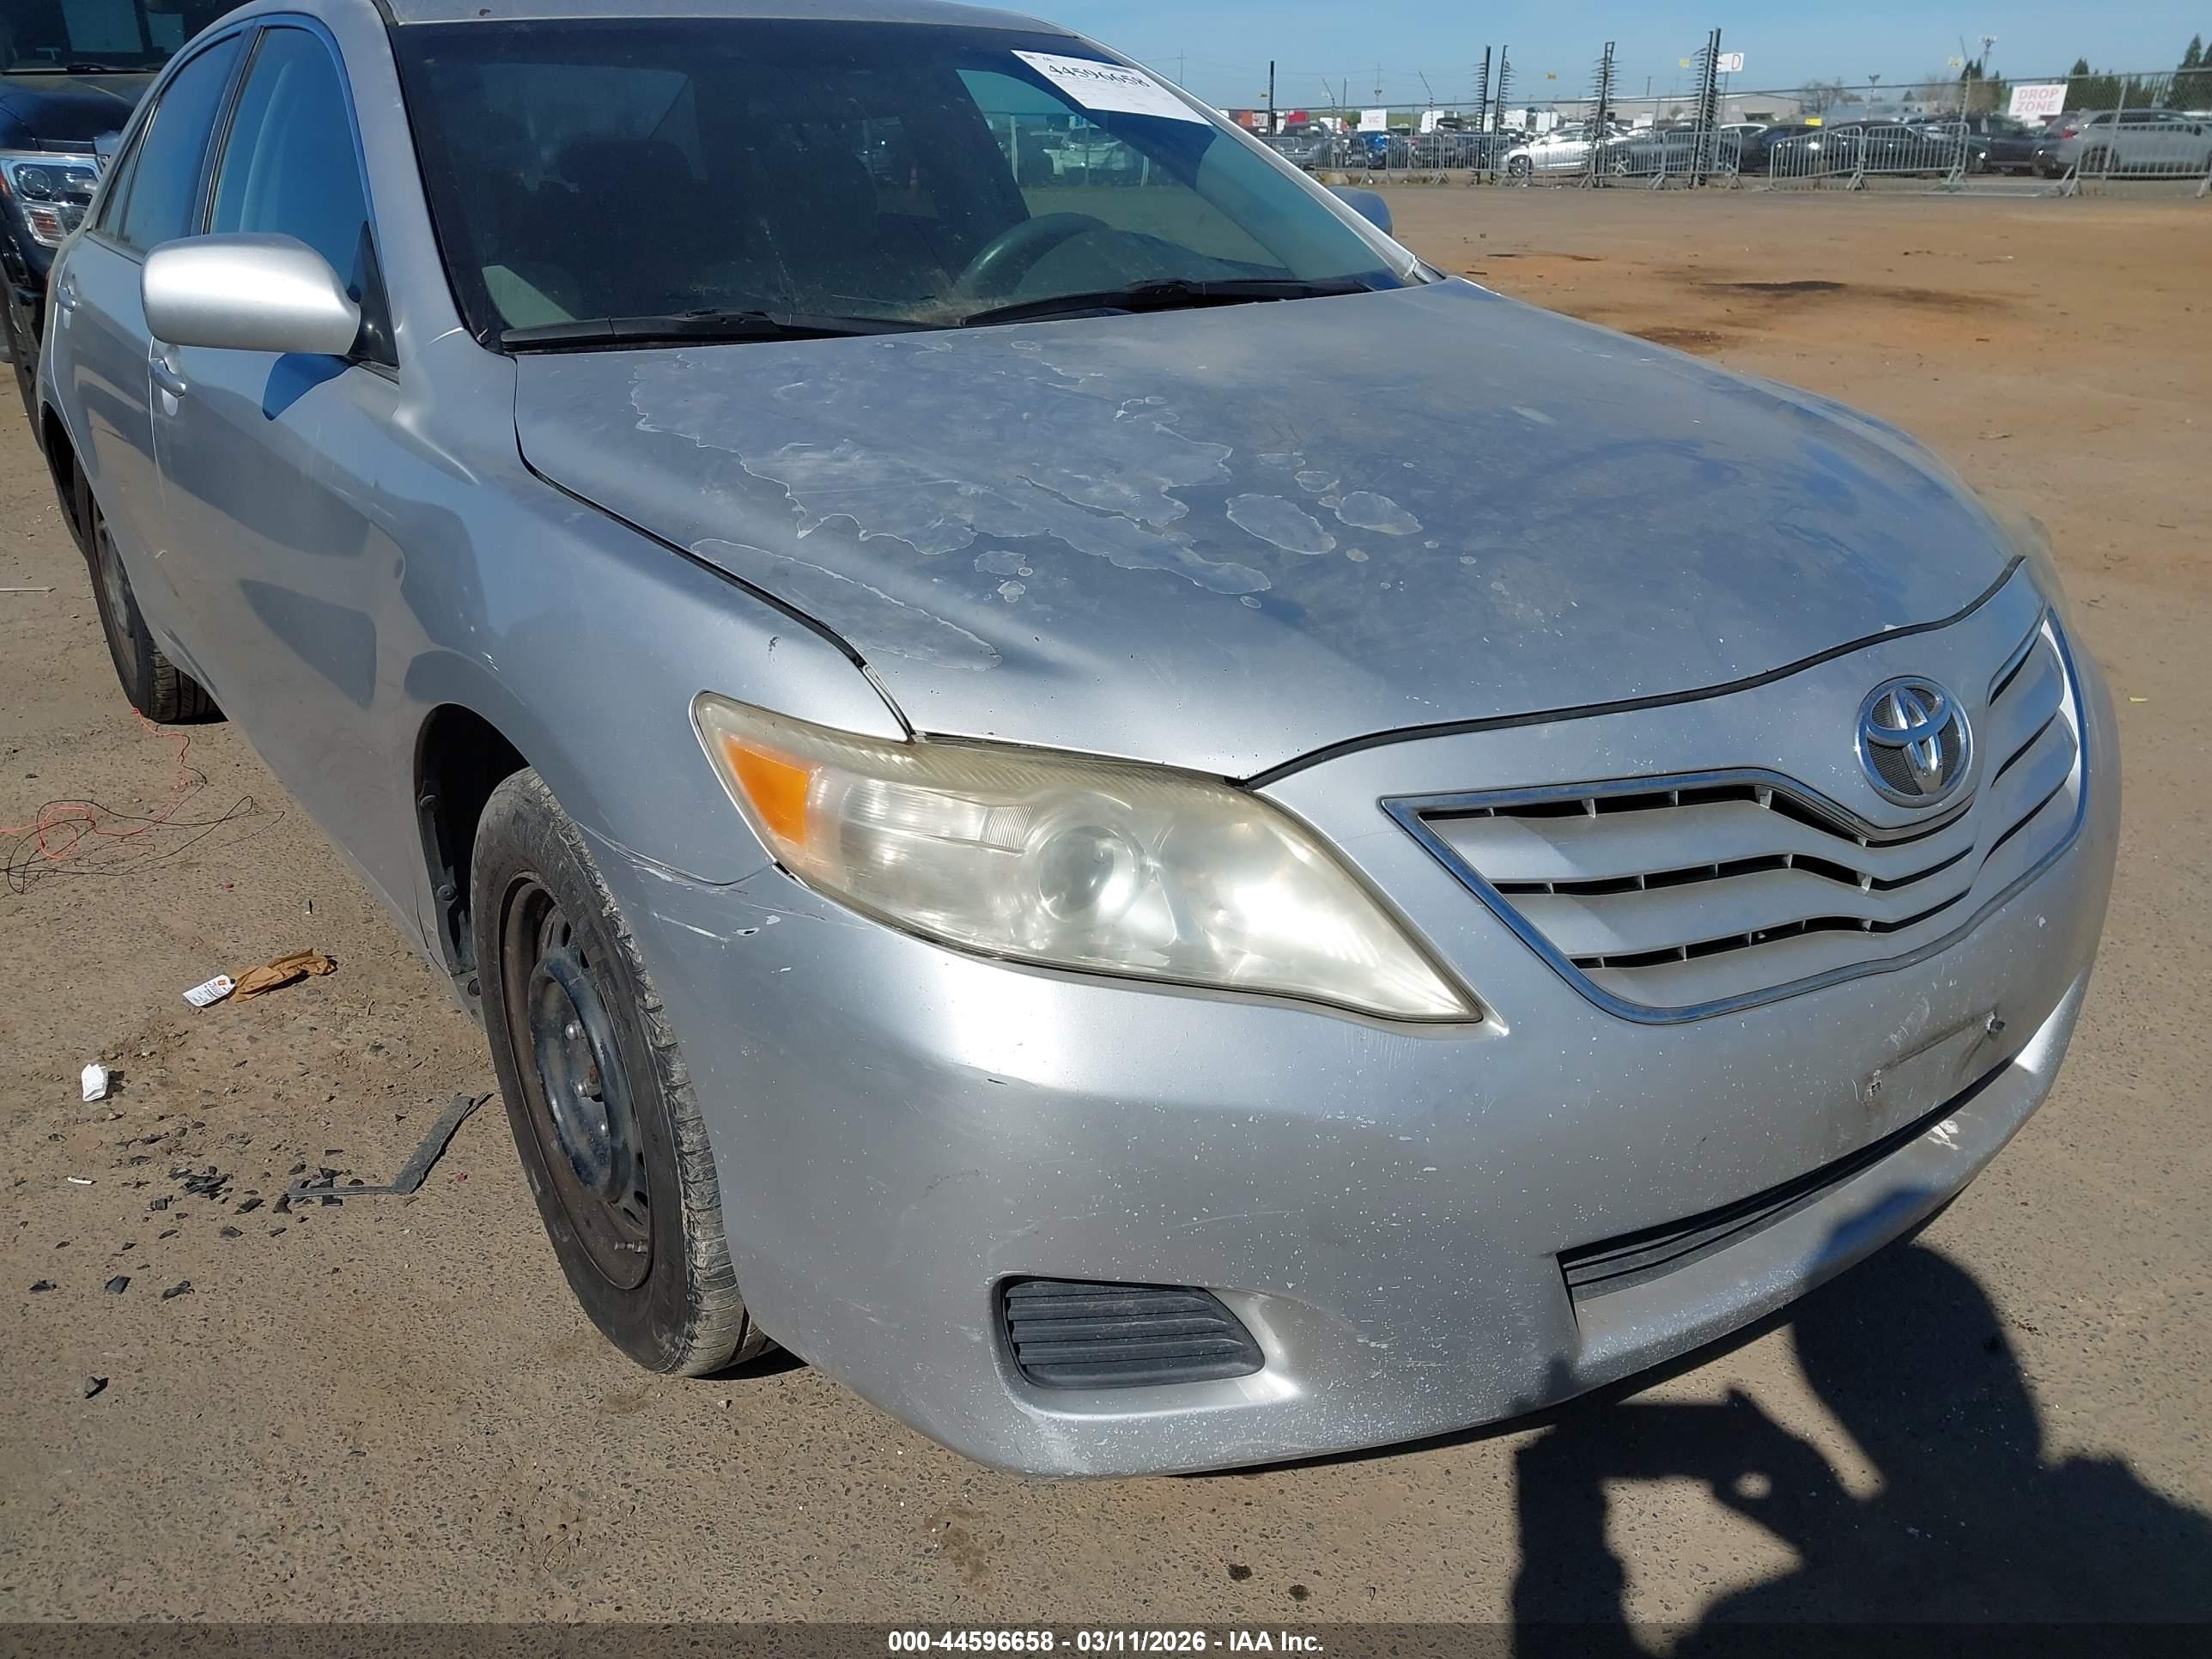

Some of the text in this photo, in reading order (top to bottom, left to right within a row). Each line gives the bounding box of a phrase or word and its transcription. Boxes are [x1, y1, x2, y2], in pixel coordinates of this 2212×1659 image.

[1048, 64, 1151, 88] 44596658
[2019, 88, 2060, 100] DROP
[2015, 100, 2057, 112] ZONE
